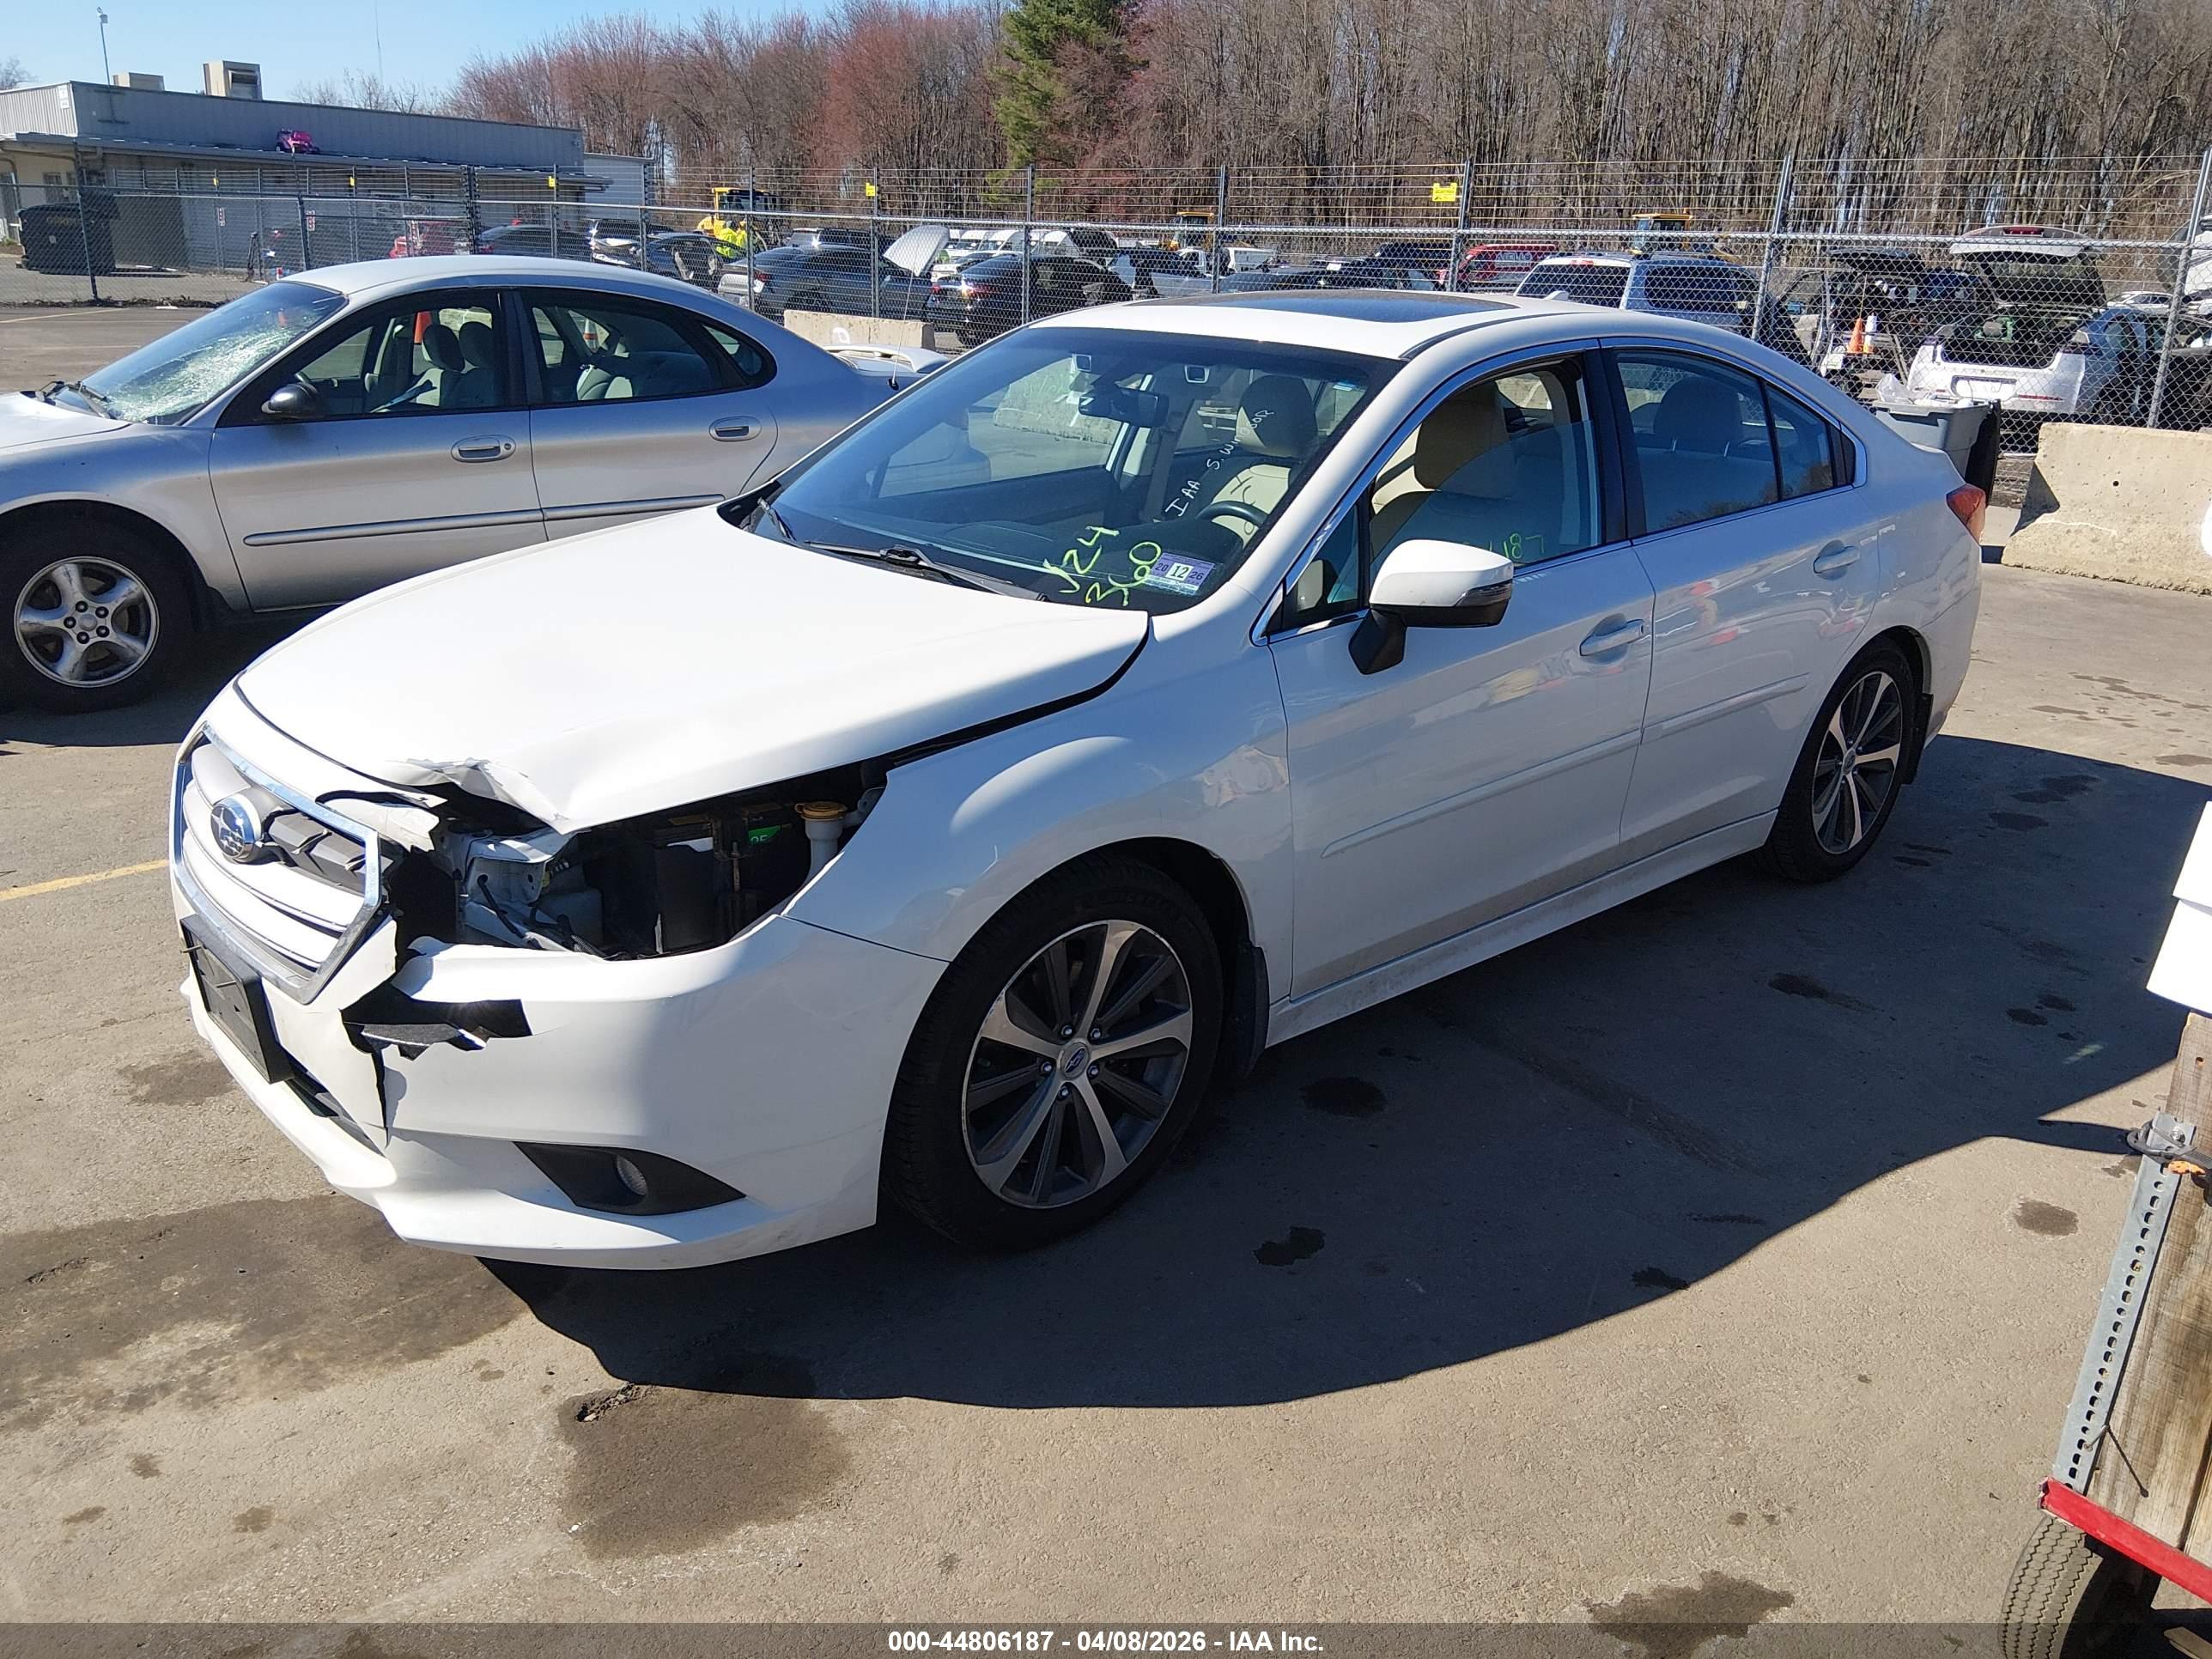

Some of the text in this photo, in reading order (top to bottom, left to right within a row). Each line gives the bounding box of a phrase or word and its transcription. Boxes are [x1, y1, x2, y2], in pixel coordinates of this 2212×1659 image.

[1164, 480, 1200, 517] IAA
[1085, 541, 1161, 606] 360
[1155, 562, 1204, 580] 20 12 26
